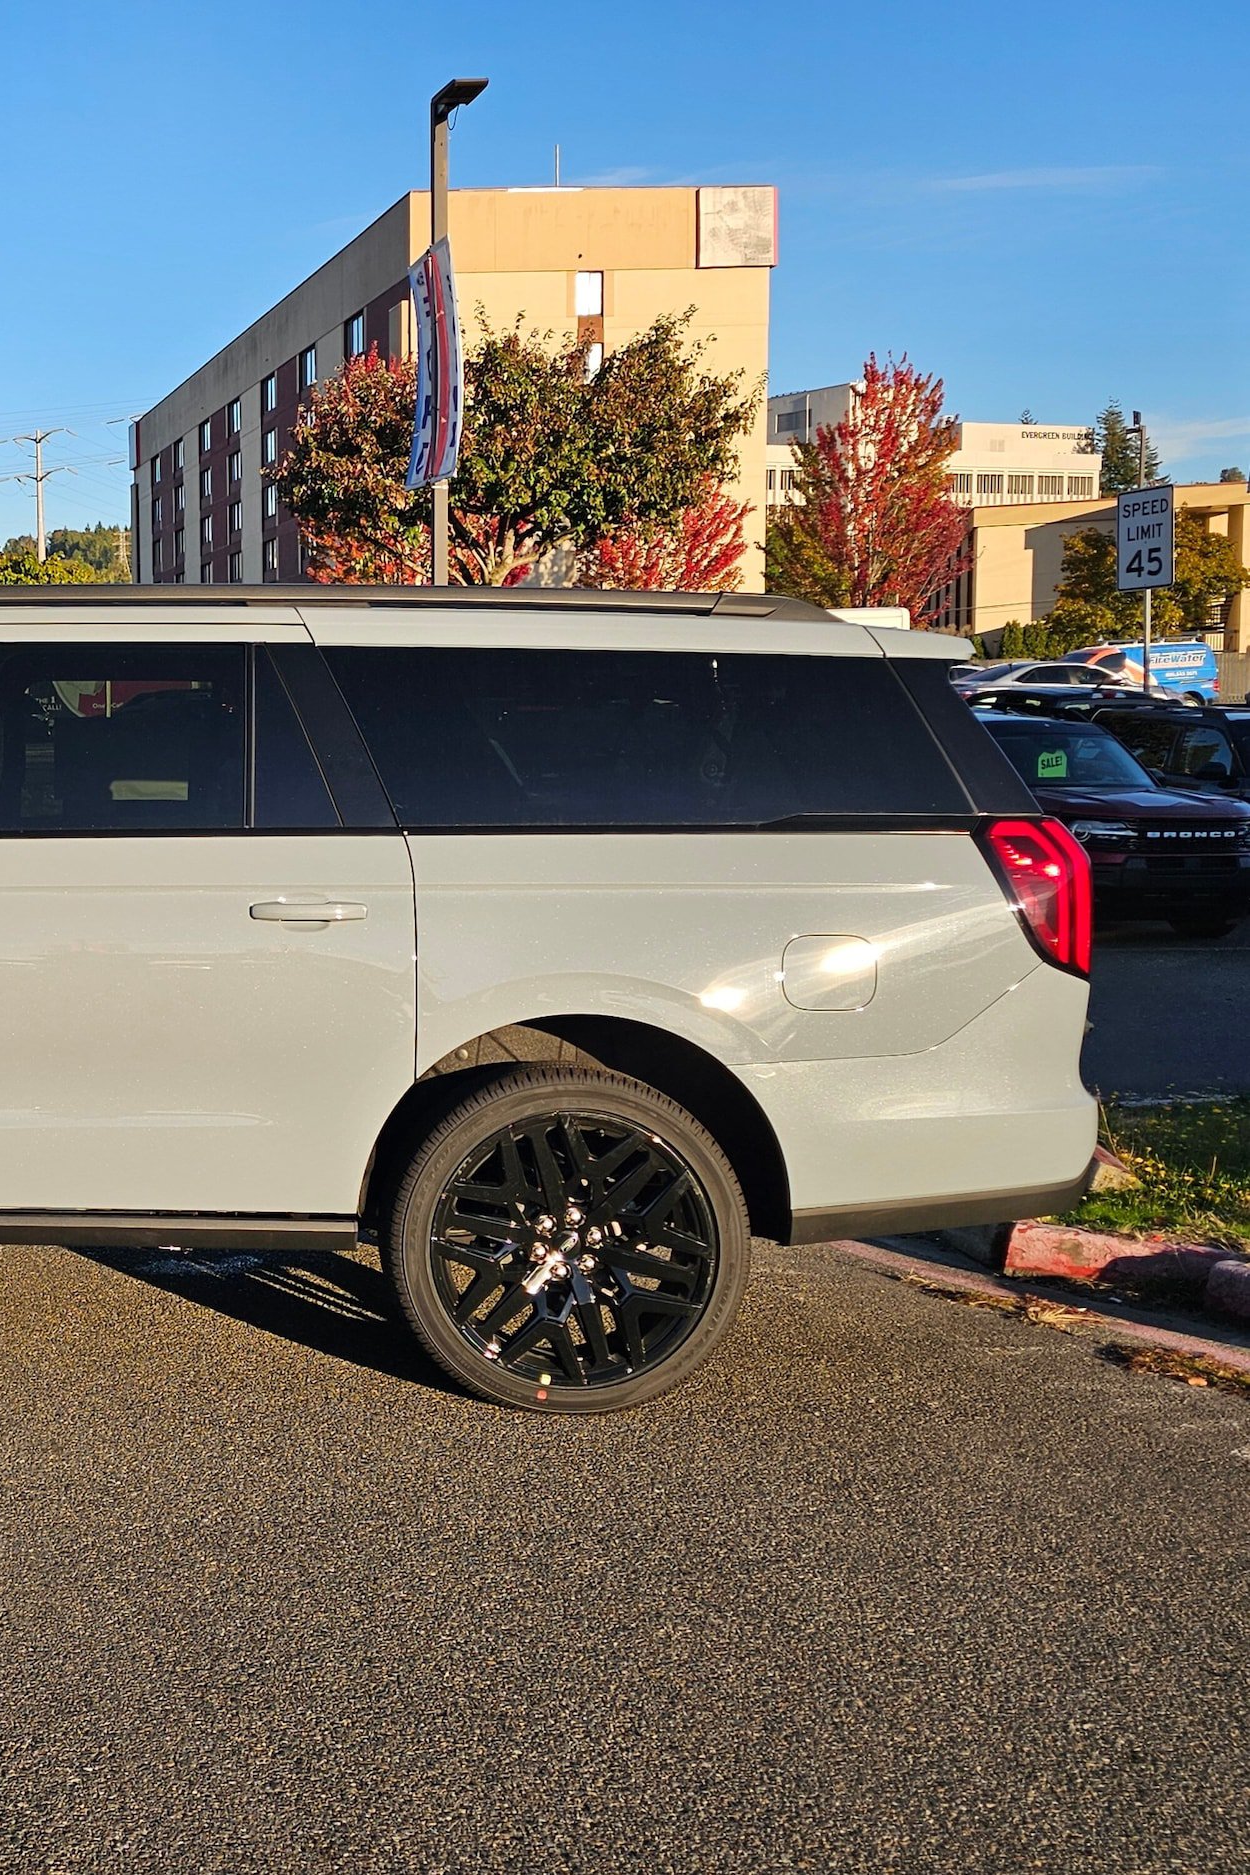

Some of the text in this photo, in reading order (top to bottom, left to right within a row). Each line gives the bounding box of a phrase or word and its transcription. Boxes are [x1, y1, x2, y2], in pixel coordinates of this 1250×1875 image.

[1021, 431, 1060, 439] EVERGREEN
[1122, 498, 1169, 519] SPEED
[1127, 522, 1163, 541] LIMIT
[1125, 546, 1163, 578] 45
